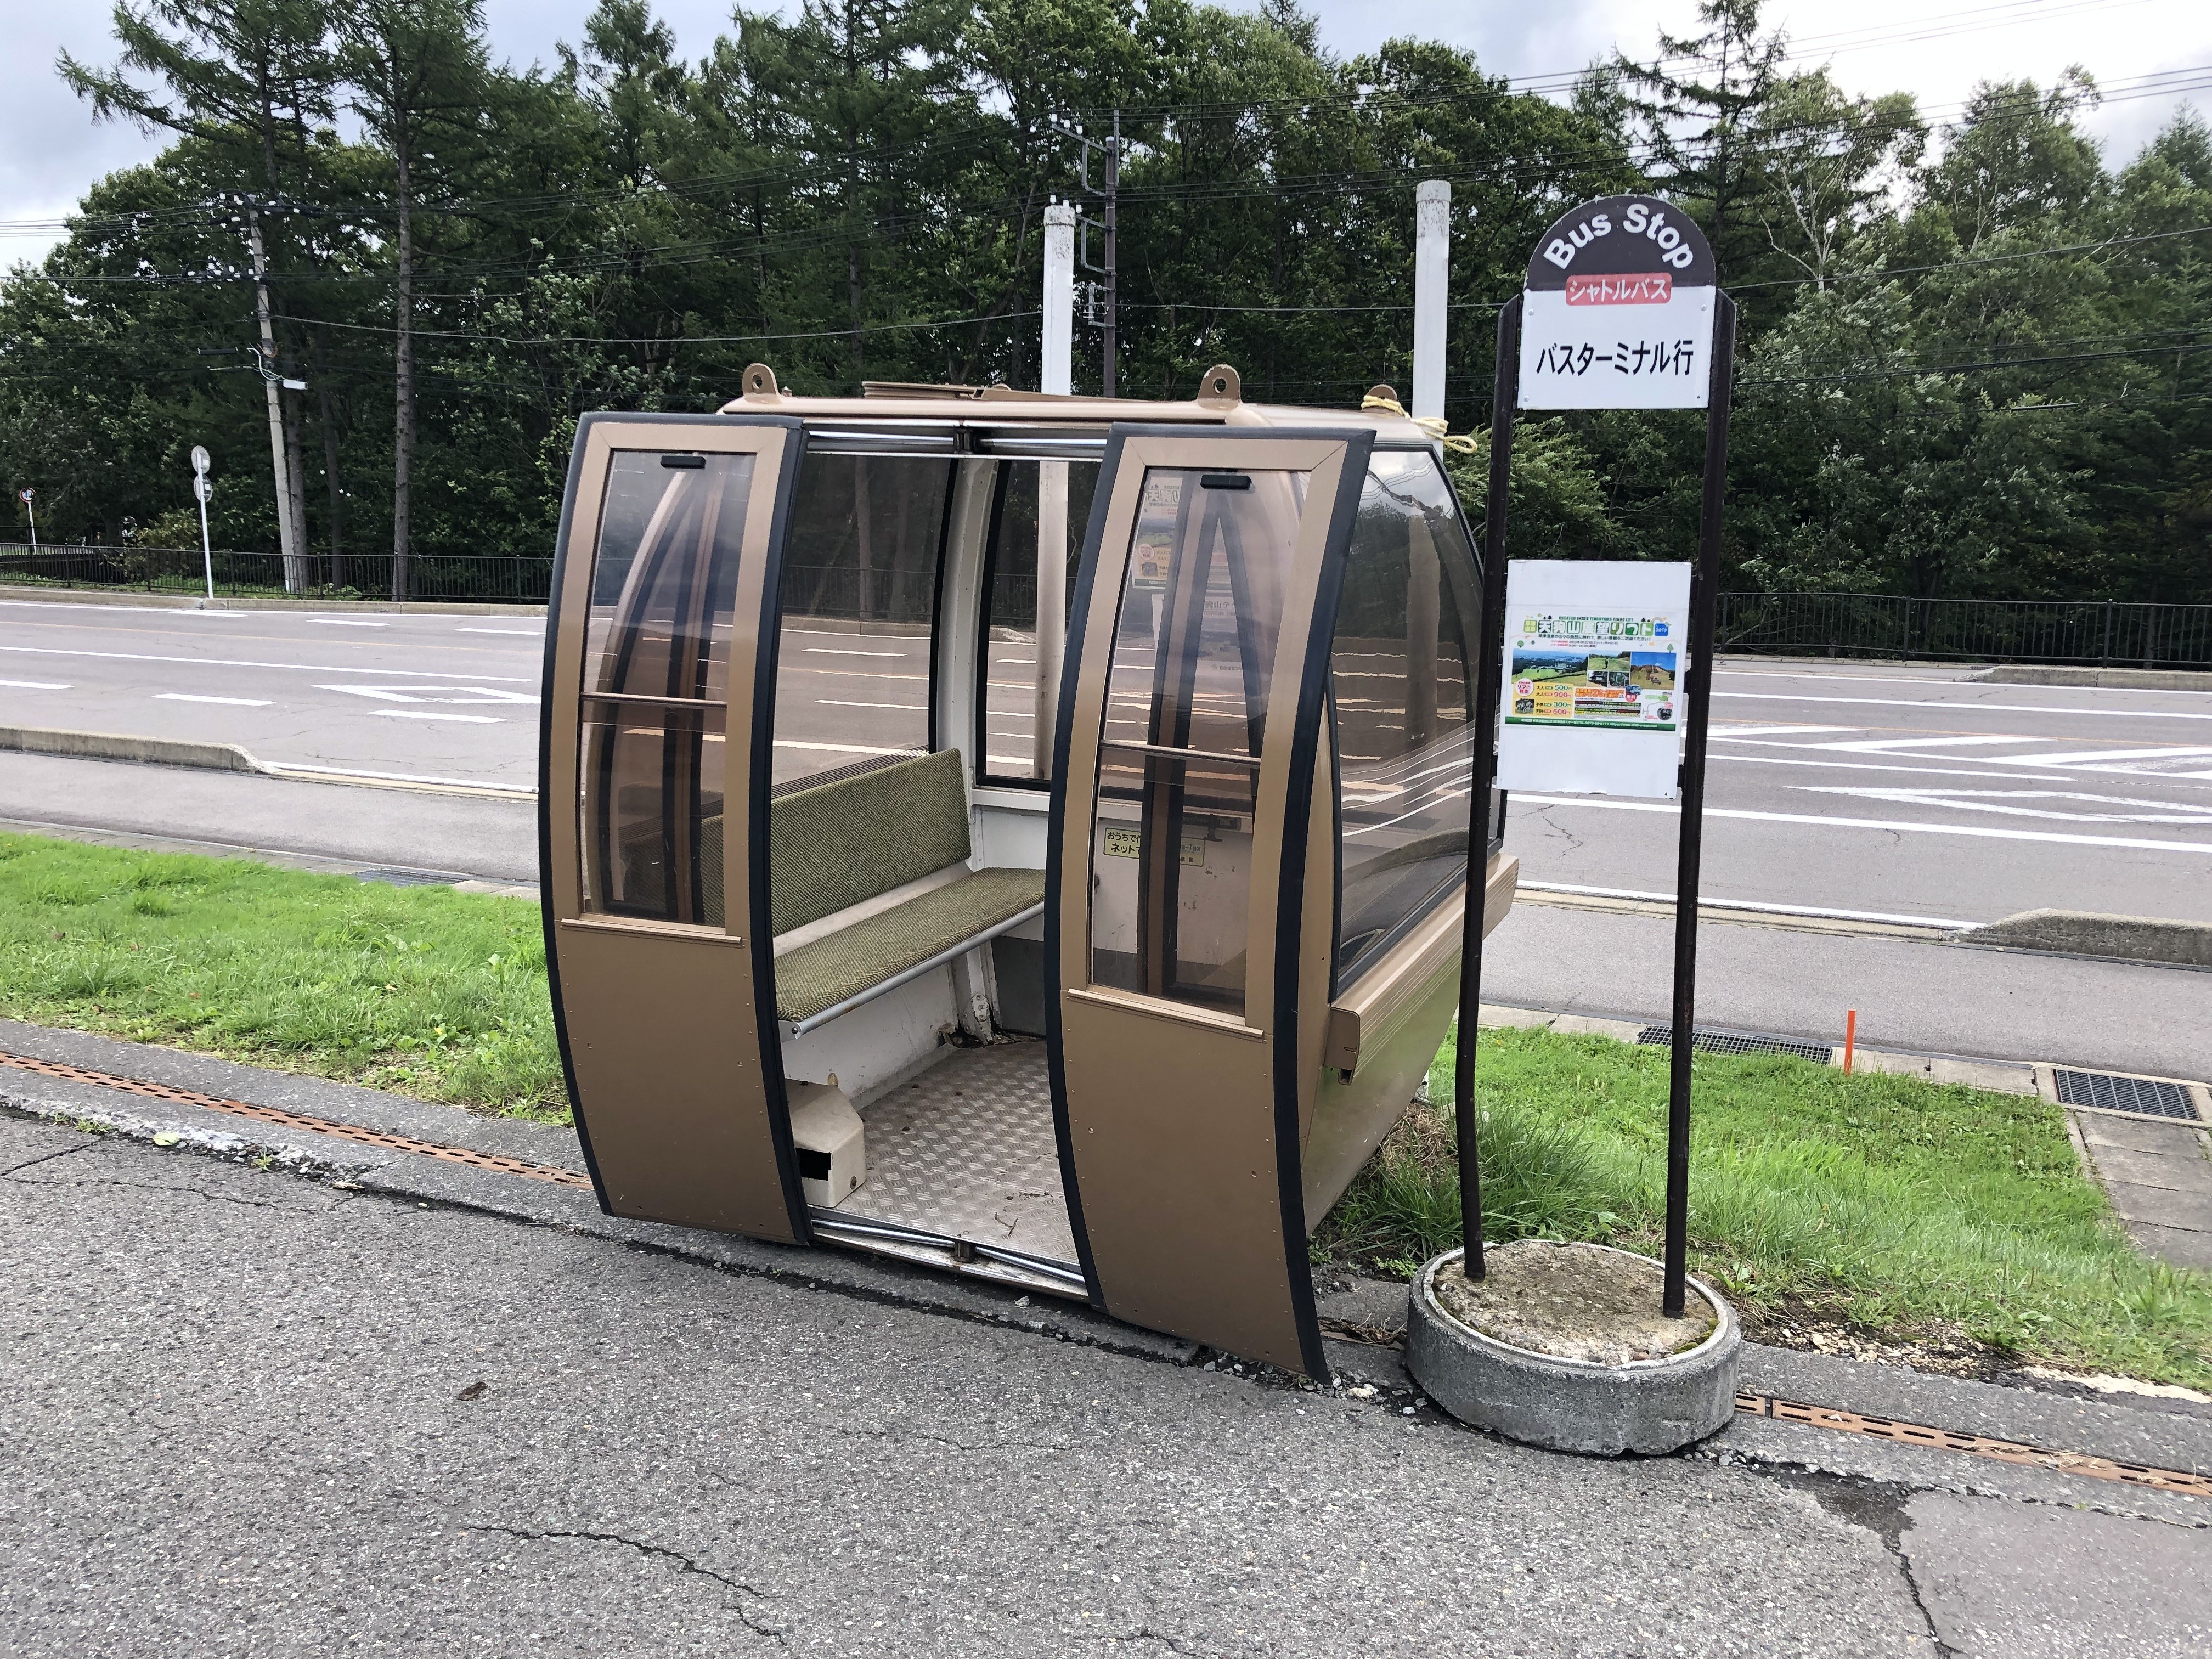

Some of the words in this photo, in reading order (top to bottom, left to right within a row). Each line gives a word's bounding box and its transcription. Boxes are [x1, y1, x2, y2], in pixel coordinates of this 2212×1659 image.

[1543, 213, 1612, 269] Bus
[1623, 204, 1694, 269] Stop
[1569, 278, 1668, 302] シャトルバス
[1536, 339, 1694, 377] バスターミナル行
